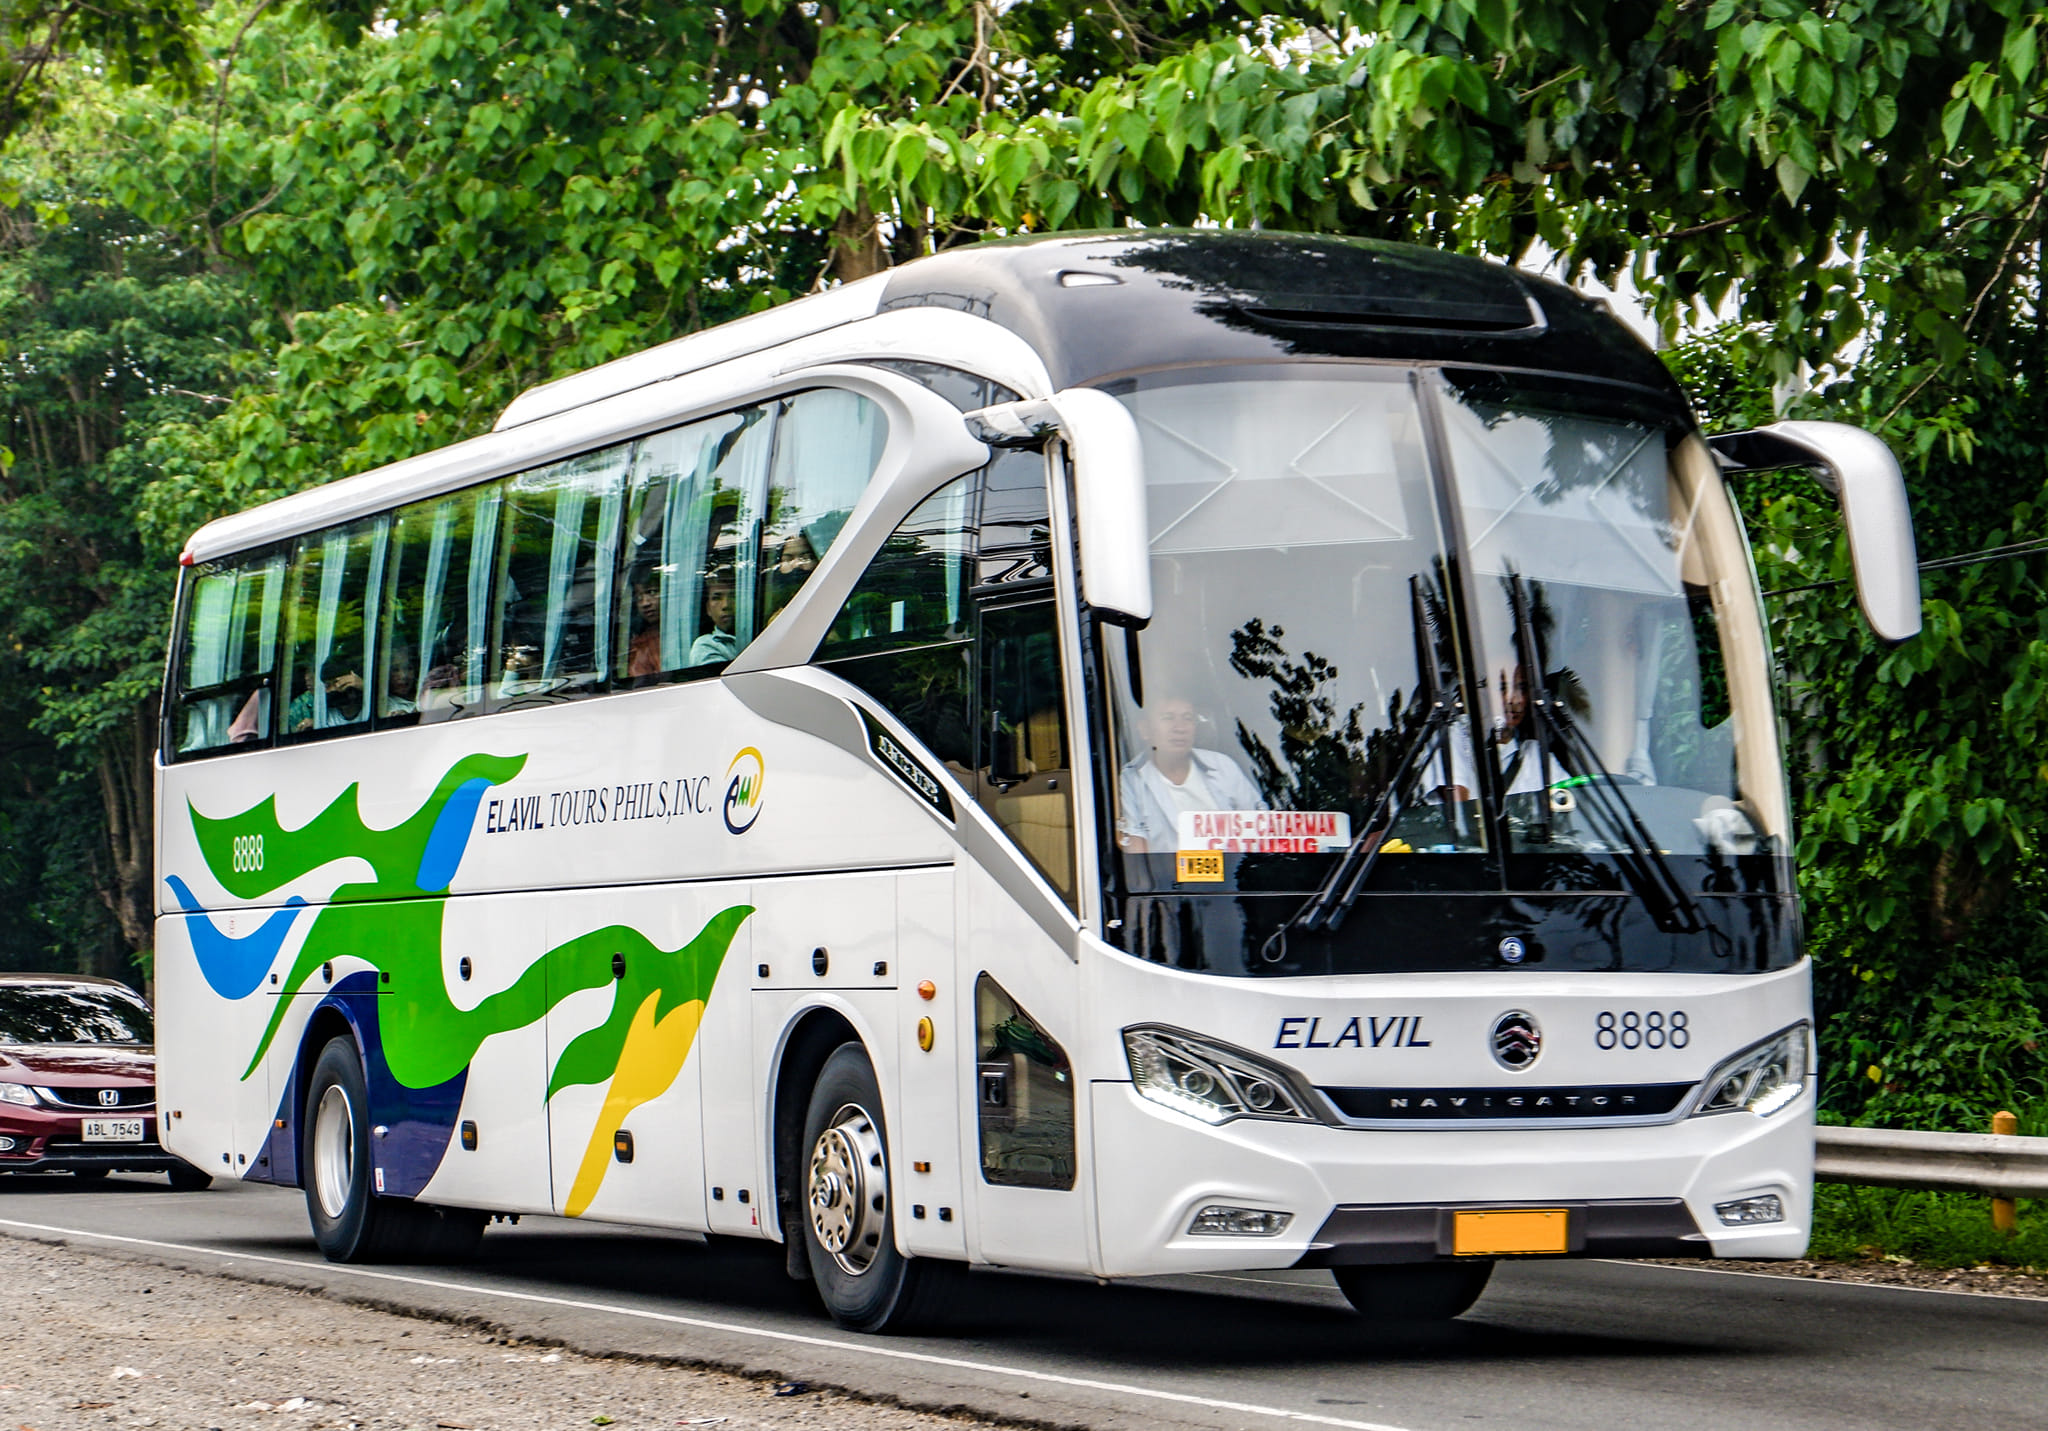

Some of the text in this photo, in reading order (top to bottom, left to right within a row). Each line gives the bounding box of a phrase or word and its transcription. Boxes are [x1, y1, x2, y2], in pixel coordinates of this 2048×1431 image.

[486, 795, 545, 834] ELAVIL
[549, 787, 609, 828] TOURS
[233, 833, 264, 873] 8888
[1273, 1016, 1432, 1049] ELAVIL
[1595, 1010, 1691, 1050] 8888
[1390, 1095, 1636, 1108] NAVIGATOR
[87, 1123, 140, 1136] ABL 7549
